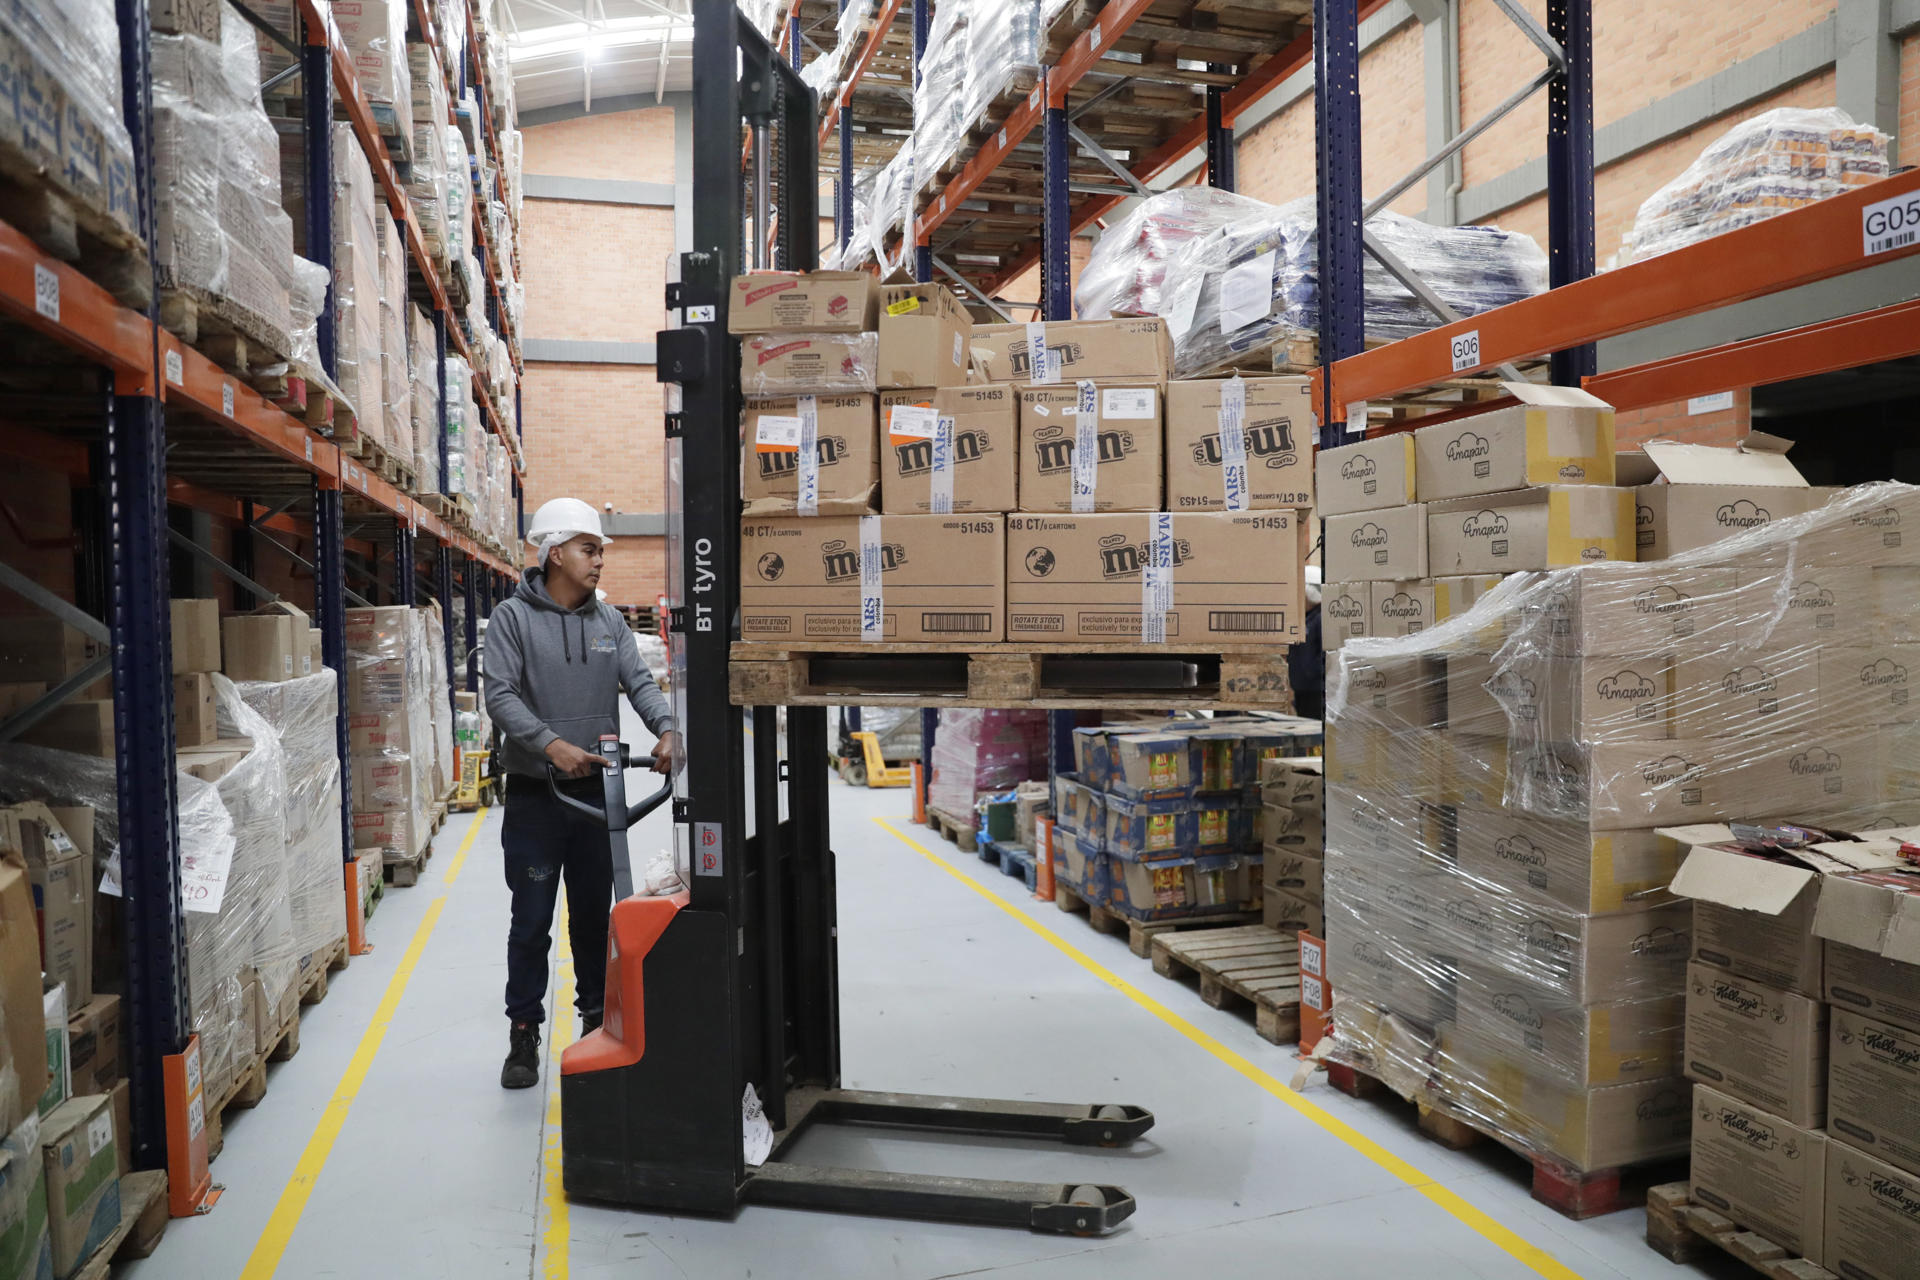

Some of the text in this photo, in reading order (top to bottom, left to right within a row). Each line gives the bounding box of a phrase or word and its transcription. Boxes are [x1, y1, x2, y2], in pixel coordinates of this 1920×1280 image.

[1866, 199, 1920, 236] G05
[1453, 337, 1478, 358] G06
[1033, 335, 1046, 379] MARS
[975, 390, 1003, 401] 51453
[1023, 393, 1034, 402] 48
[1447, 444, 1489, 462] Amapan
[1342, 467, 1376, 481] Amapan
[1297, 493, 1309, 503] 48
[1010, 519, 1023, 530] 48
[1718, 513, 1770, 529] Amapan
[743, 526, 754, 537] 48
[1463, 521, 1508, 538] Amapan
[1158, 513, 1171, 568] MARS
[1352, 533, 1387, 549] Amapan
[692, 538, 716, 632] BT tyro
[1328, 606, 1363, 620] Amapan
[1382, 604, 1422, 619] Amapan
[1014, 616, 1061, 624] ROTATE STOCK
[1082, 615, 1113, 624] exclusivo
[1114, 617, 1130, 625] para
[808, 625, 841, 634] exclusively
[1082, 624, 1118, 633] exclusively
[1119, 624, 1129, 632] for
[1598, 682, 1656, 701] Amapan
[1495, 846, 1546, 868] Amapan
[1302, 945, 1320, 965] F07
[1303, 980, 1321, 1000] F08
[1715, 985, 1759, 1010] Kellogg's
[1866, 1034, 1920, 1064] Kellogg's
[1723, 1114, 1769, 1143] Kellogg's
